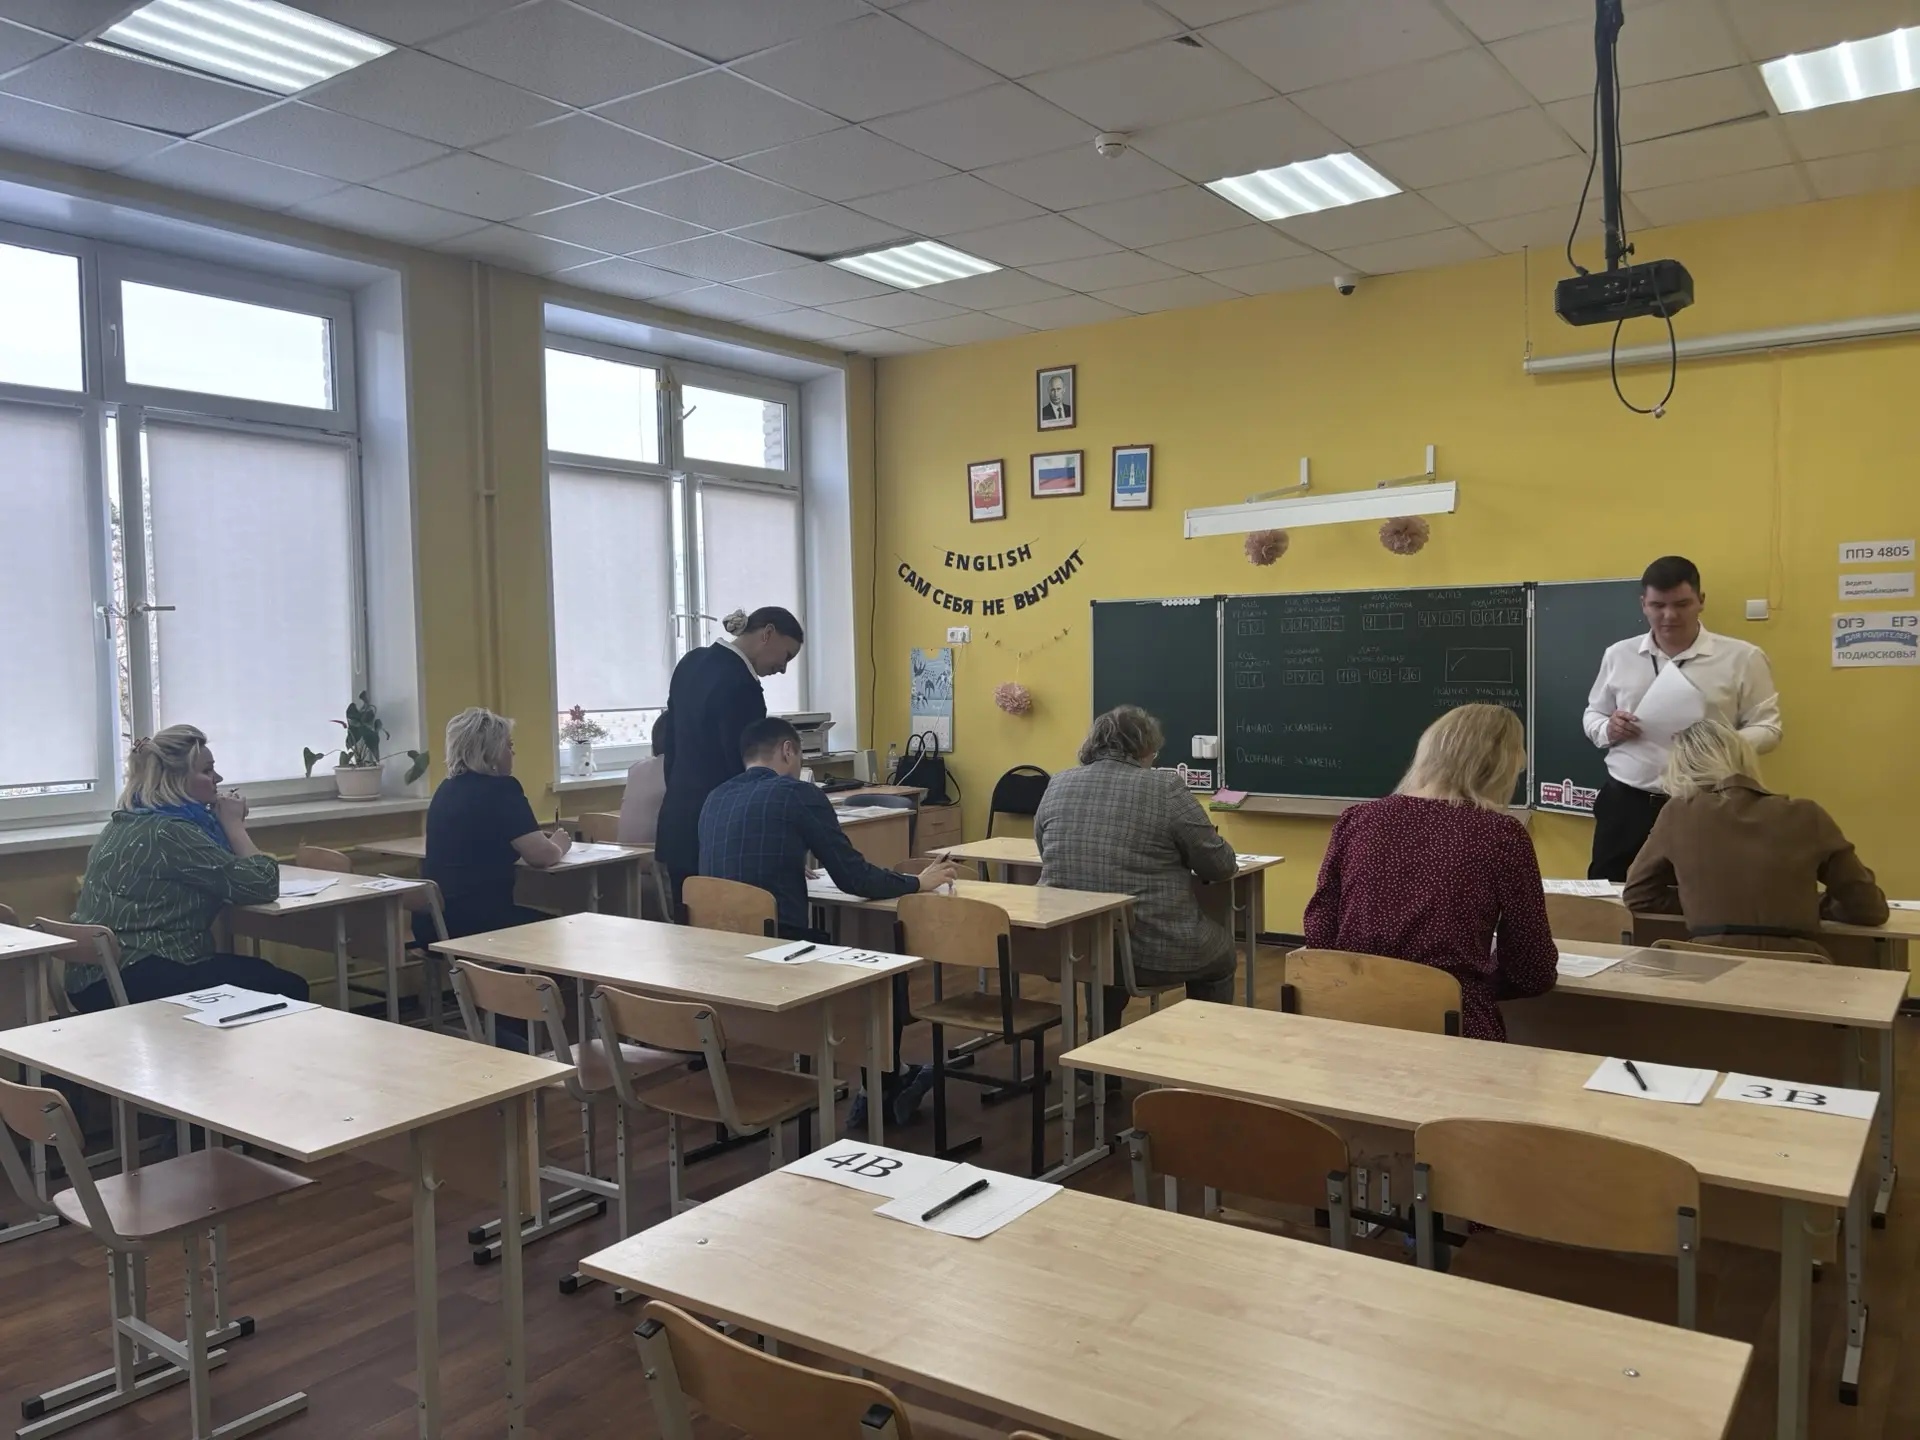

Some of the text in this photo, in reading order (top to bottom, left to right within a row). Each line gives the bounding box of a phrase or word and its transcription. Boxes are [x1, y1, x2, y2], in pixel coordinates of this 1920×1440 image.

[944, 543, 1032, 572] ENGLISH
[1845, 546, 1910, 560] ППЭ 4805
[897, 549, 1085, 616] САМ СЕБЯ НЕ ВЫУЧИТ
[1837, 618, 1865, 629] ОГЭ
[1892, 616, 1918, 627] ЕГЭ
[1845, 633, 1861, 643] ДЛЯ
[1838, 650, 1917, 660] ПОДМОСКОВЬЯ
